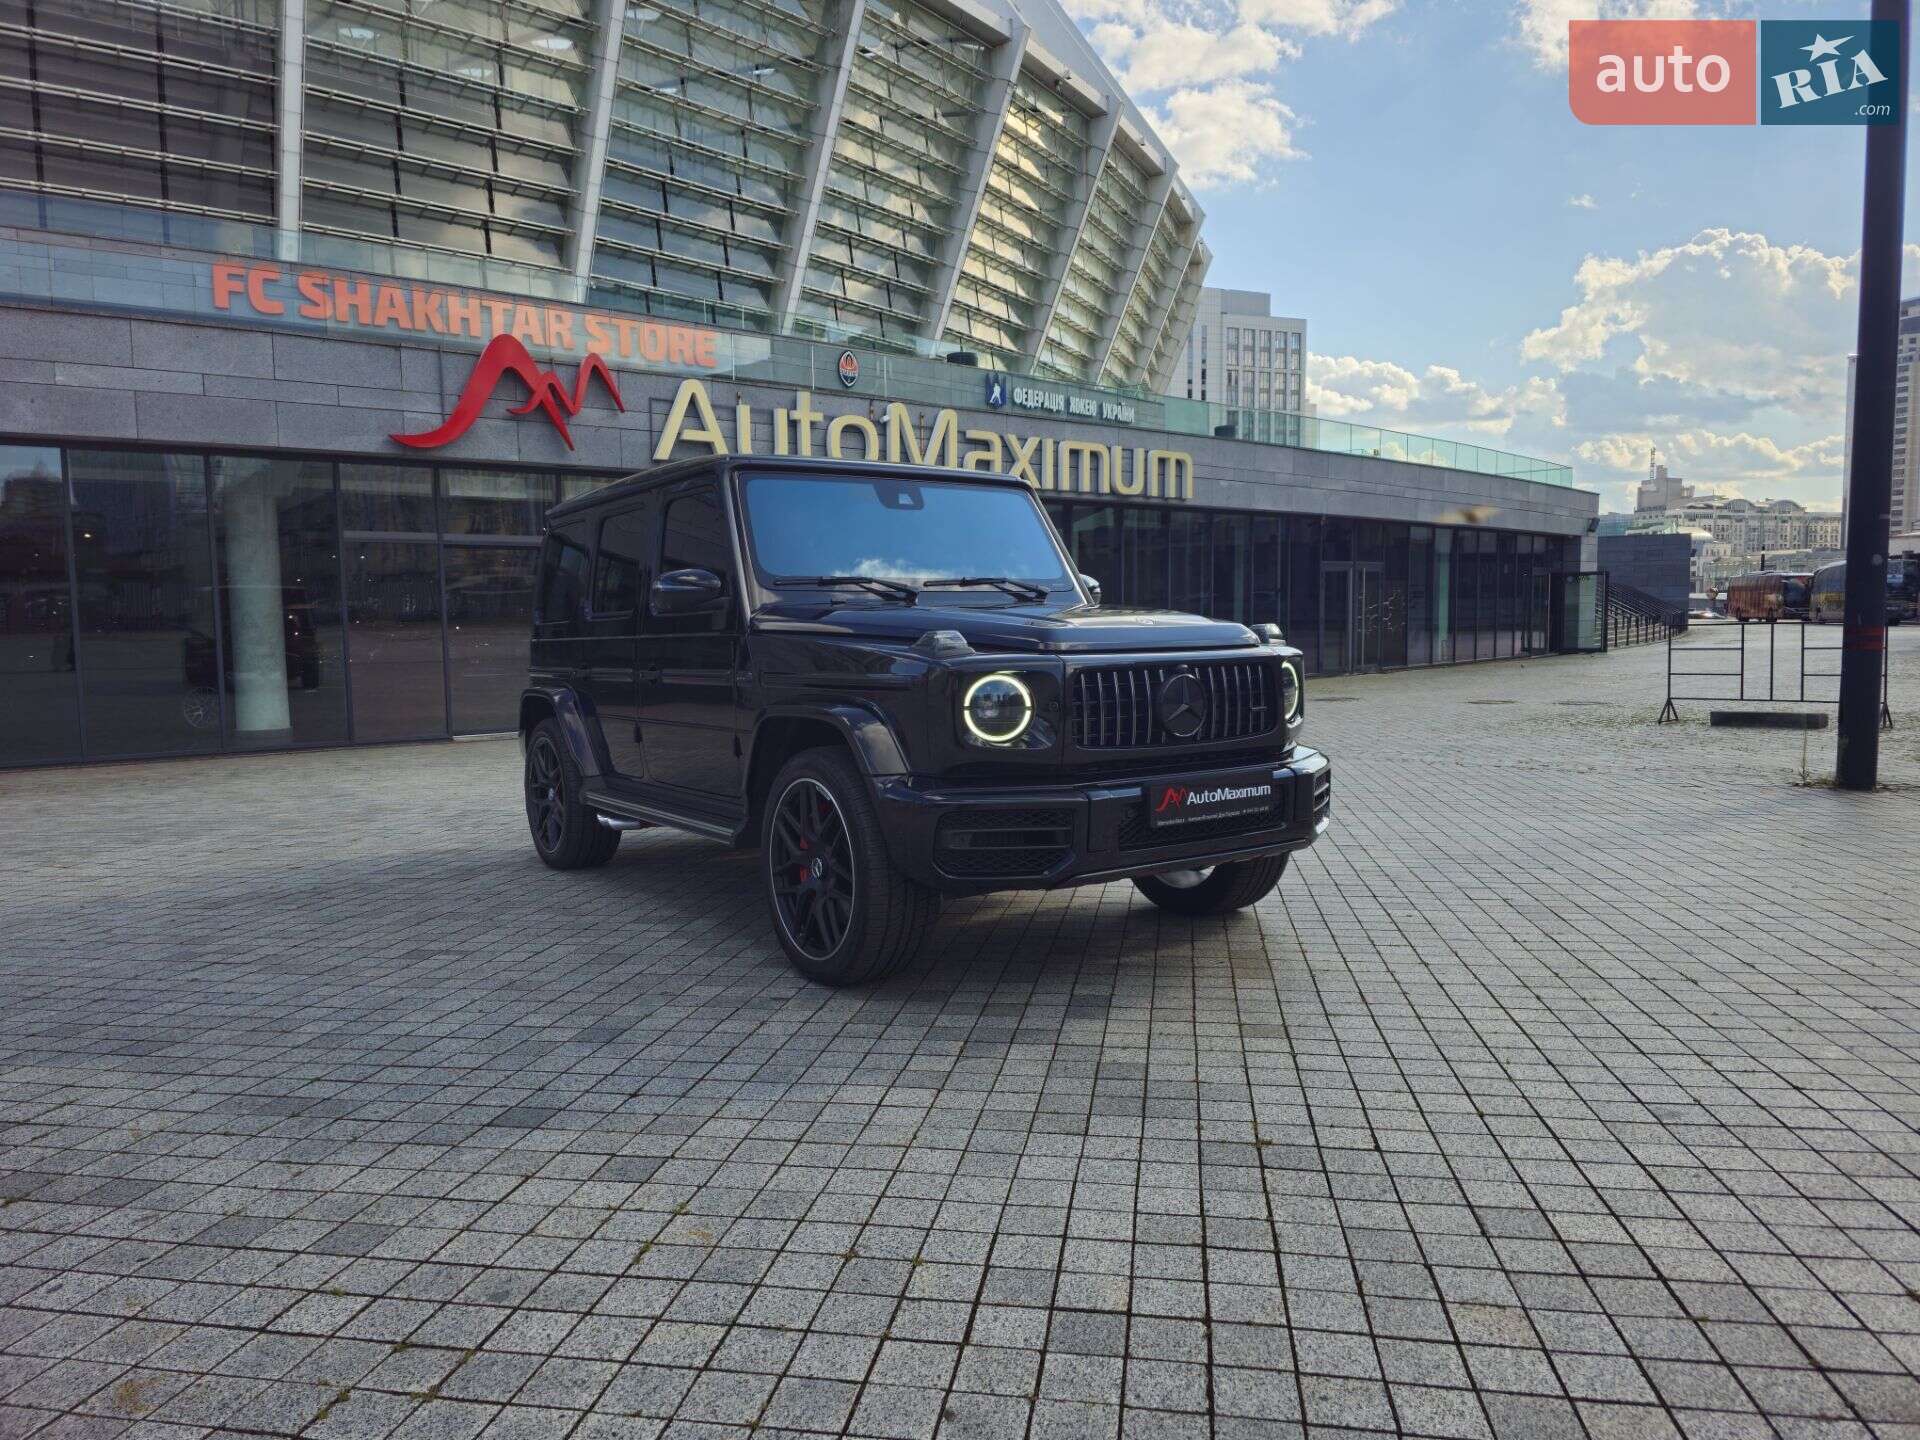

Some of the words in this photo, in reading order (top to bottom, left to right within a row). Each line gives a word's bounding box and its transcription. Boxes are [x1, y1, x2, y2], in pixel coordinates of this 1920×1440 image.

[212, 262, 284, 315] FC
[297, 269, 575, 350] SHAKHTAR
[585, 313, 718, 368] STORE
[652, 378, 1194, 500] AutoMaximum
[1187, 785, 1272, 805] AutoMaximum
